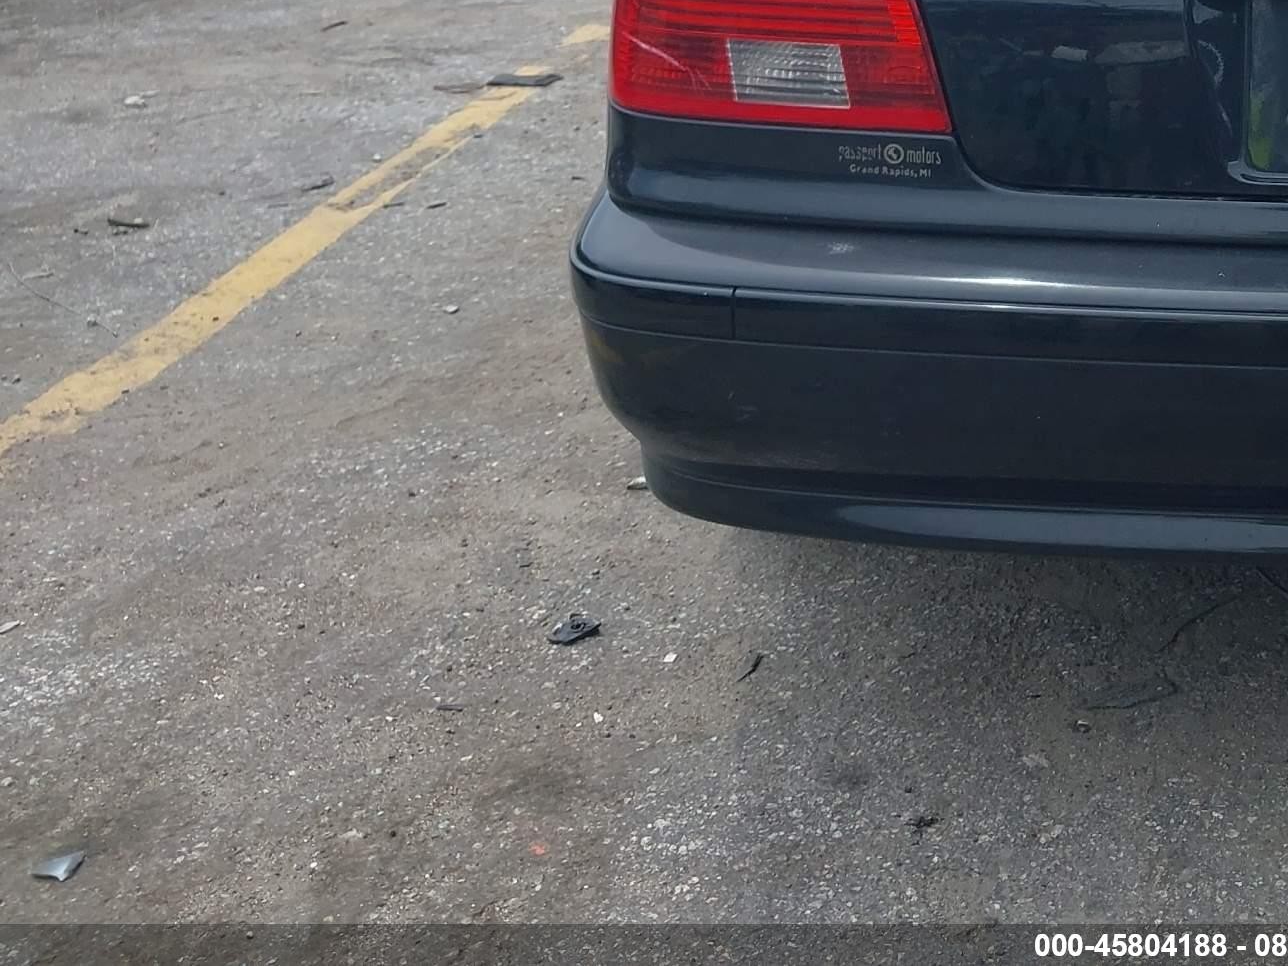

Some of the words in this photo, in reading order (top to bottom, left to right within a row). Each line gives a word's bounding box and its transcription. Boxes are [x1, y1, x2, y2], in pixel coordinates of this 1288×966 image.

[906, 146, 942, 165] motors
[849, 163, 880, 175] Grand
[881, 165, 918, 179] Rapids,
[920, 168, 932, 179] MI
